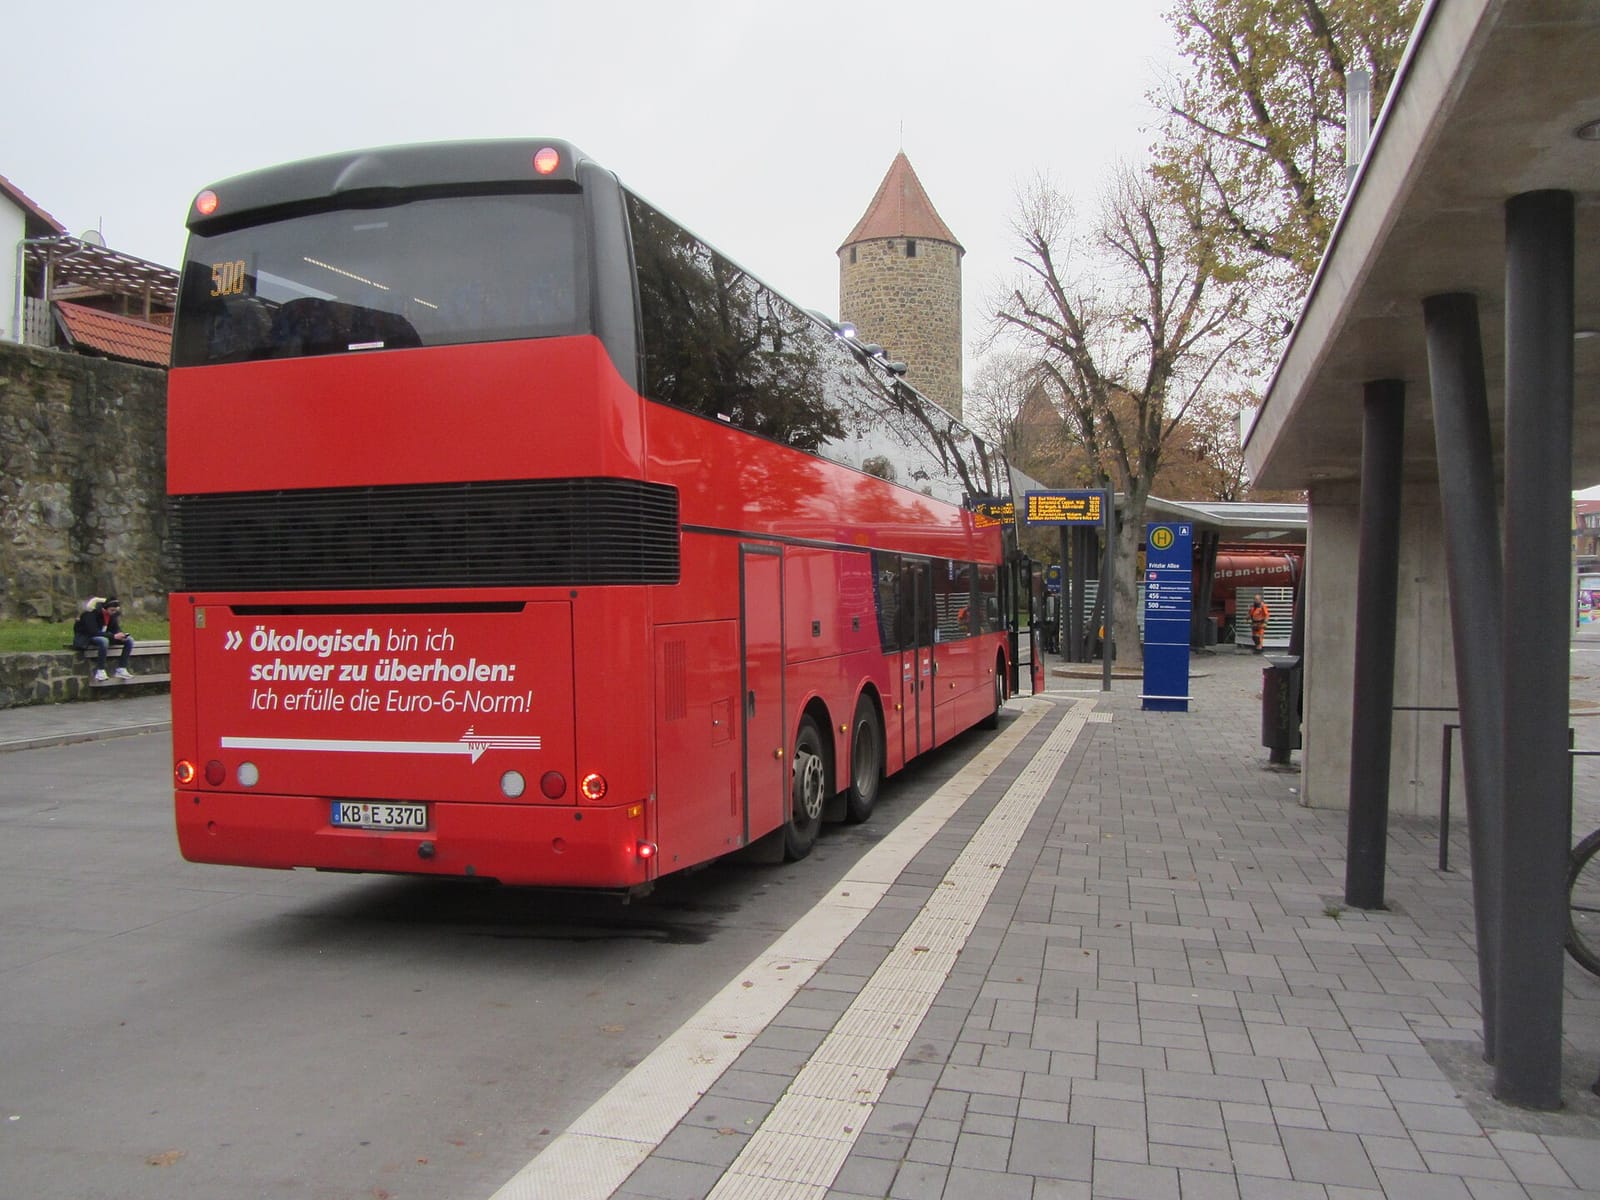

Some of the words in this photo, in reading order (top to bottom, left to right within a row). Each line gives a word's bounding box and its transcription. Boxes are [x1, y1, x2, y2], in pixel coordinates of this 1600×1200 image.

[1214, 565, 1291, 579] clean-truck
[250, 625, 381, 657] Ökologisch
[386, 628, 419, 652] bin
[425, 627, 455, 652] ich
[250, 658, 334, 681] schwer
[338, 664, 368, 682] zu
[374, 658, 516, 682] überholen:
[251, 687, 278, 710] Ich
[283, 687, 345, 711] erfülle
[350, 688, 380, 712] die
[385, 689, 533, 713] Euro-6-Norm!
[341, 805, 361, 822] KB
[371, 806, 381, 823] E
[385, 807, 424, 825] 3370
